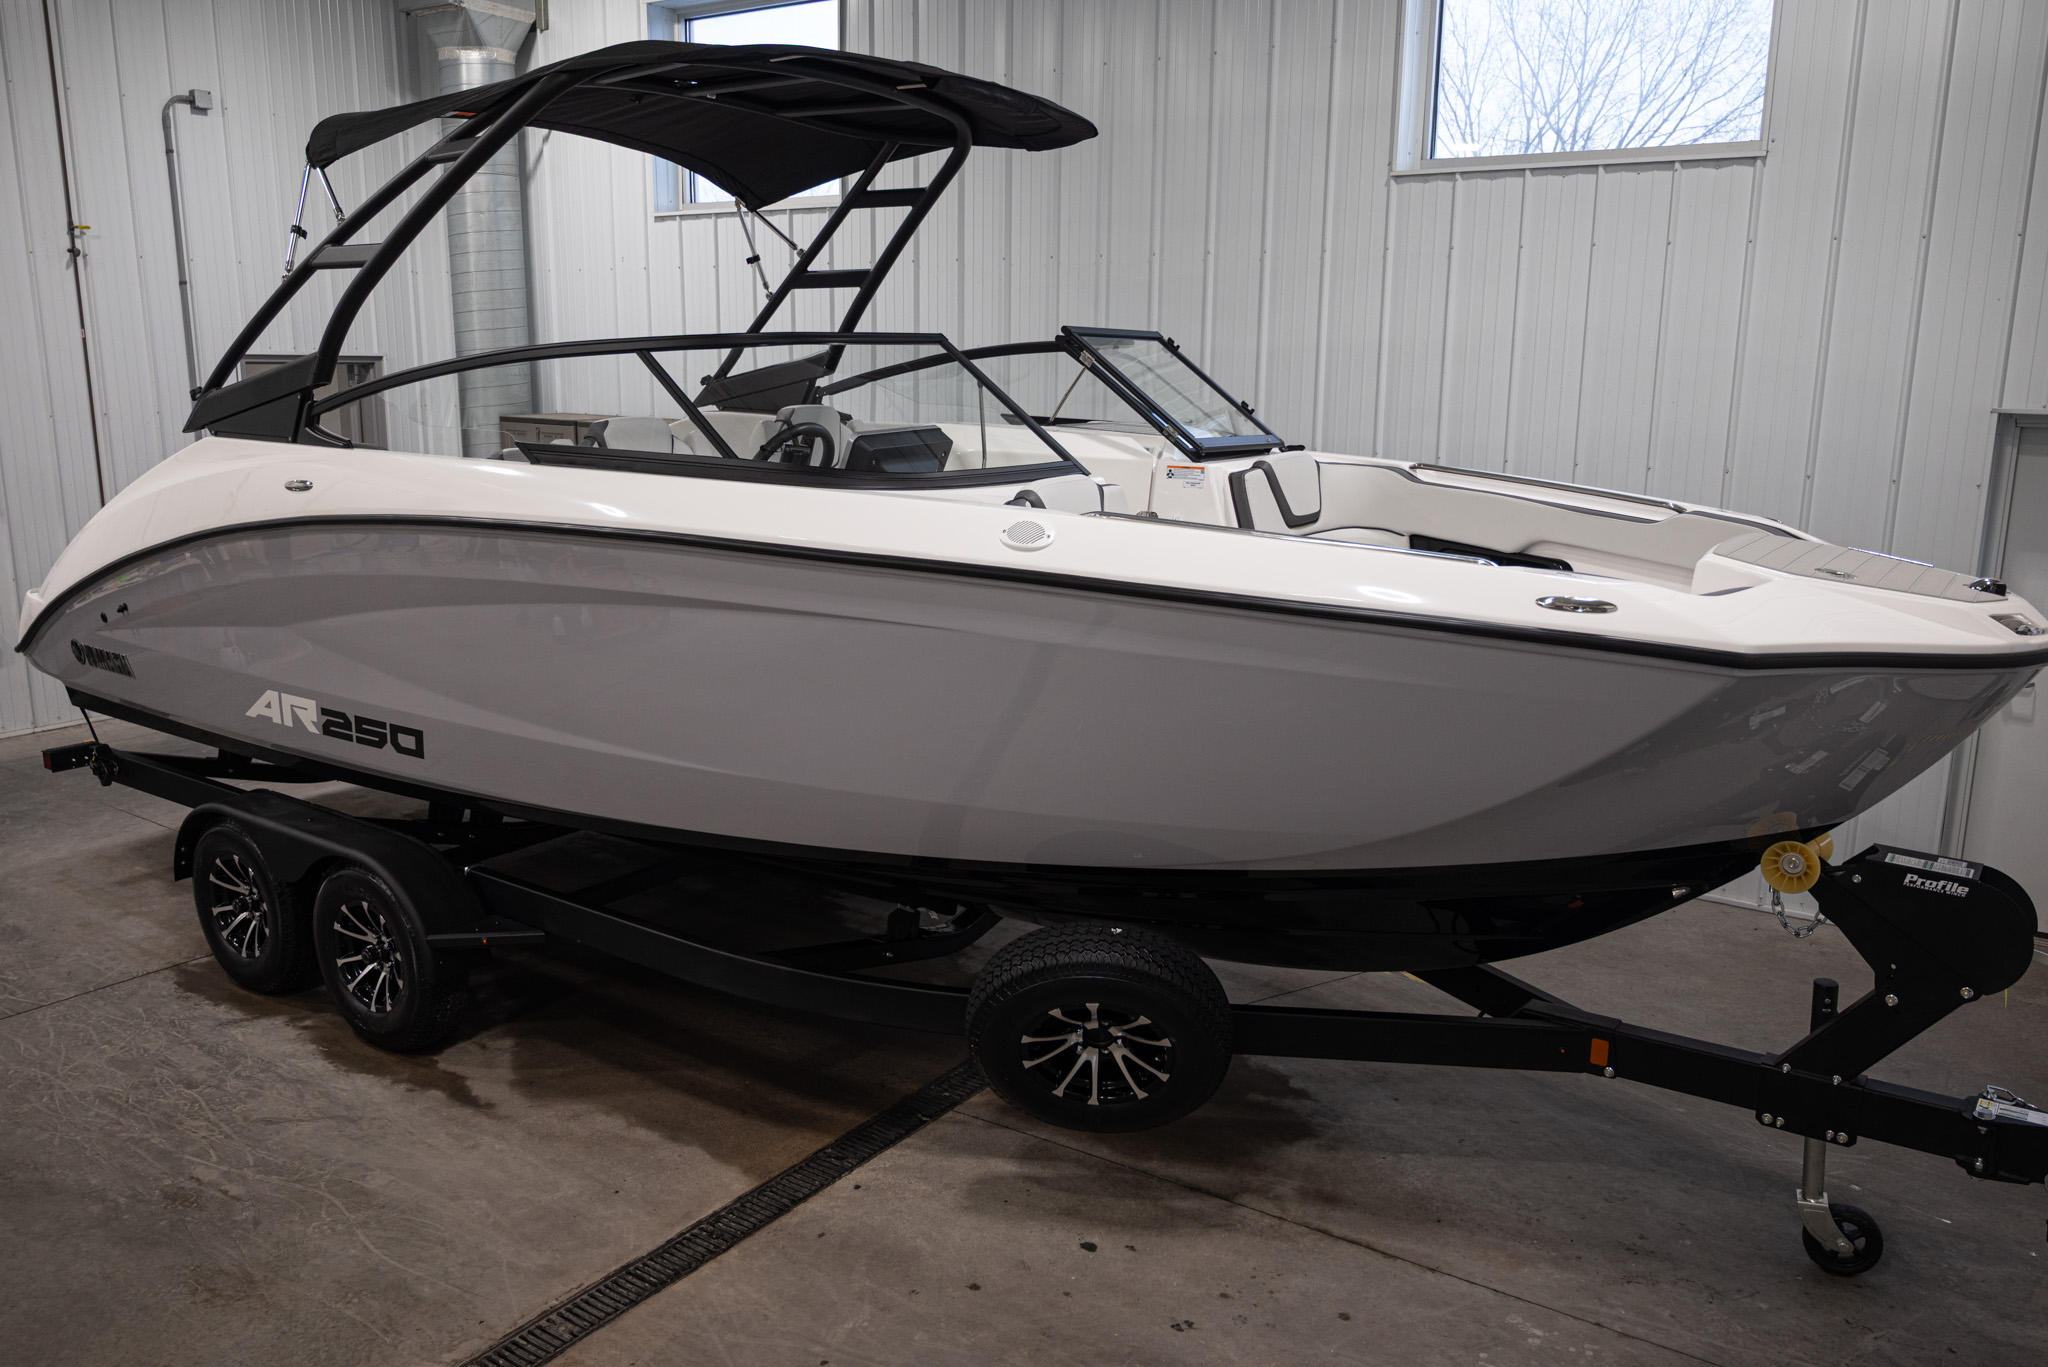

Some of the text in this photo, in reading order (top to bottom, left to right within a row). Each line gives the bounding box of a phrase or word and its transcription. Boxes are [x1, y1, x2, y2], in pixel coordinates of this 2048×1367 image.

[1903, 873, 1970, 895] Profile
[1903, 882, 1966, 898] PERFORMANCE WINCH
